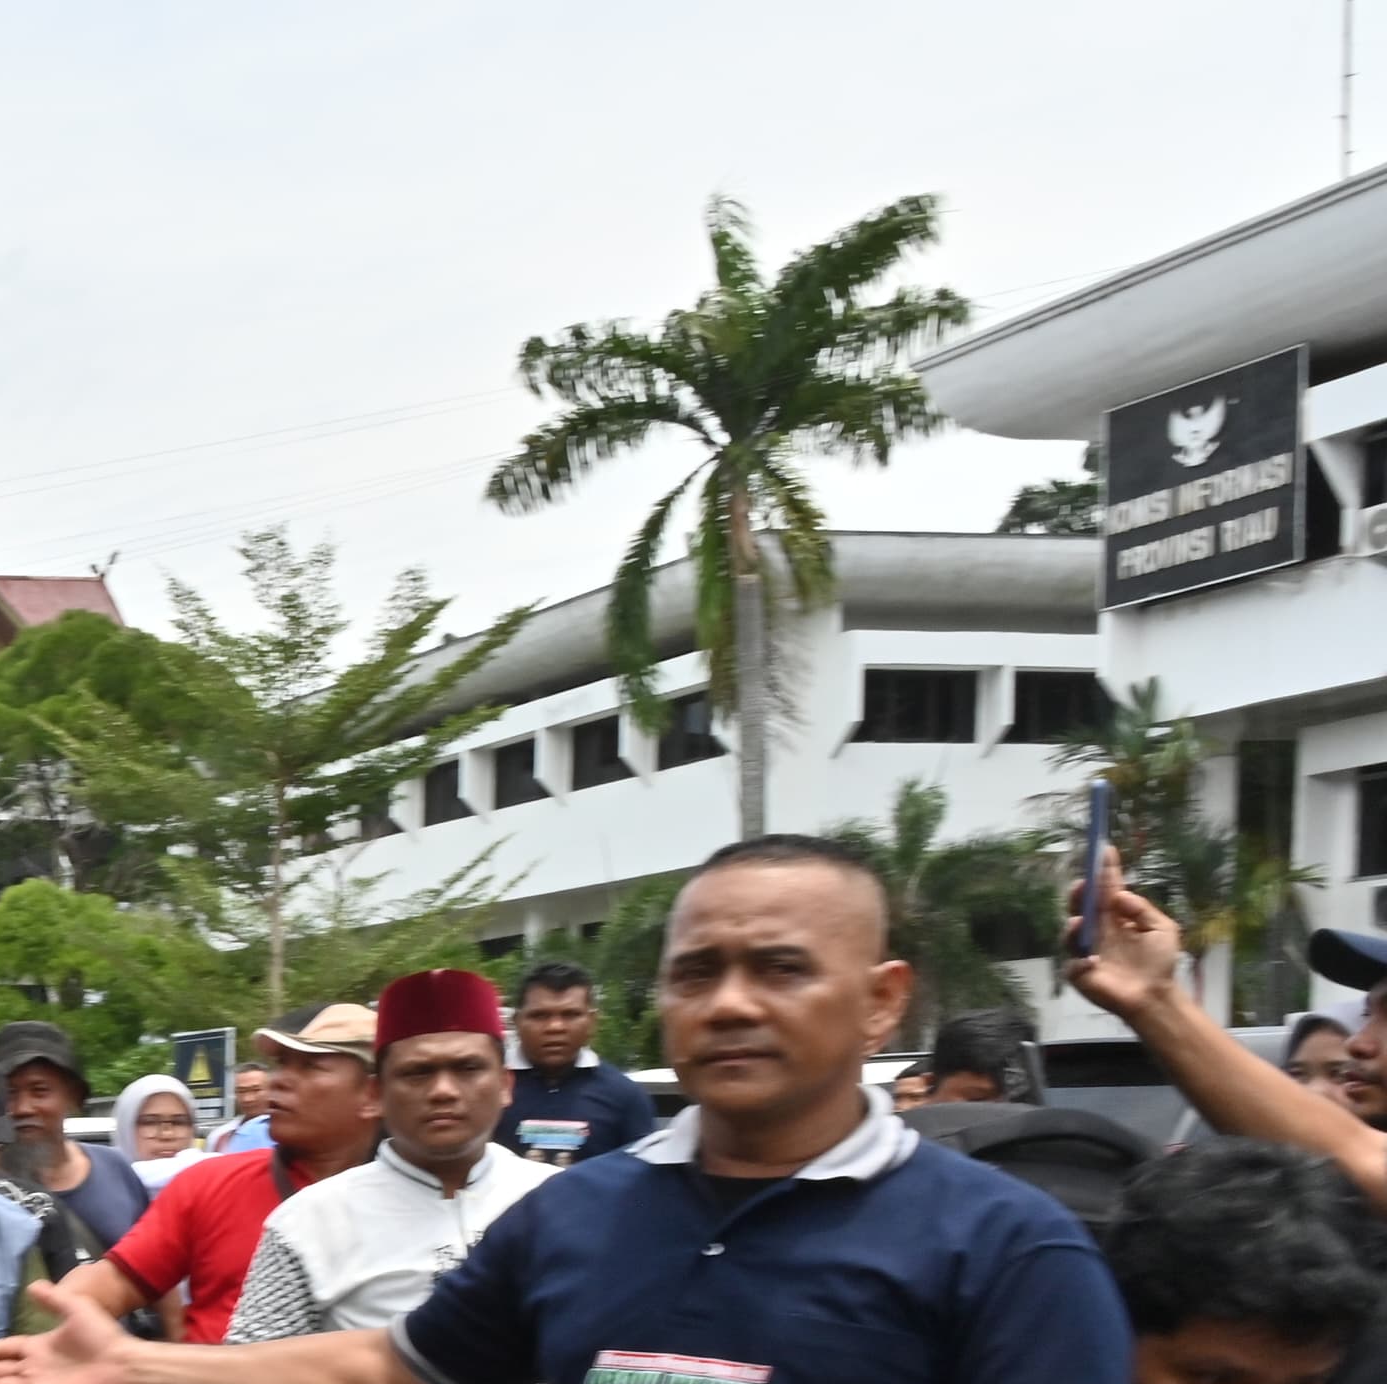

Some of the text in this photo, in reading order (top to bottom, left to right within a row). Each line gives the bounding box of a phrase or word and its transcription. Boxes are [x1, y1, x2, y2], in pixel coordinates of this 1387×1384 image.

[1178, 453, 1293, 514] INFORMASI
[1117, 506, 1280, 580] PROVINSI RIAU
